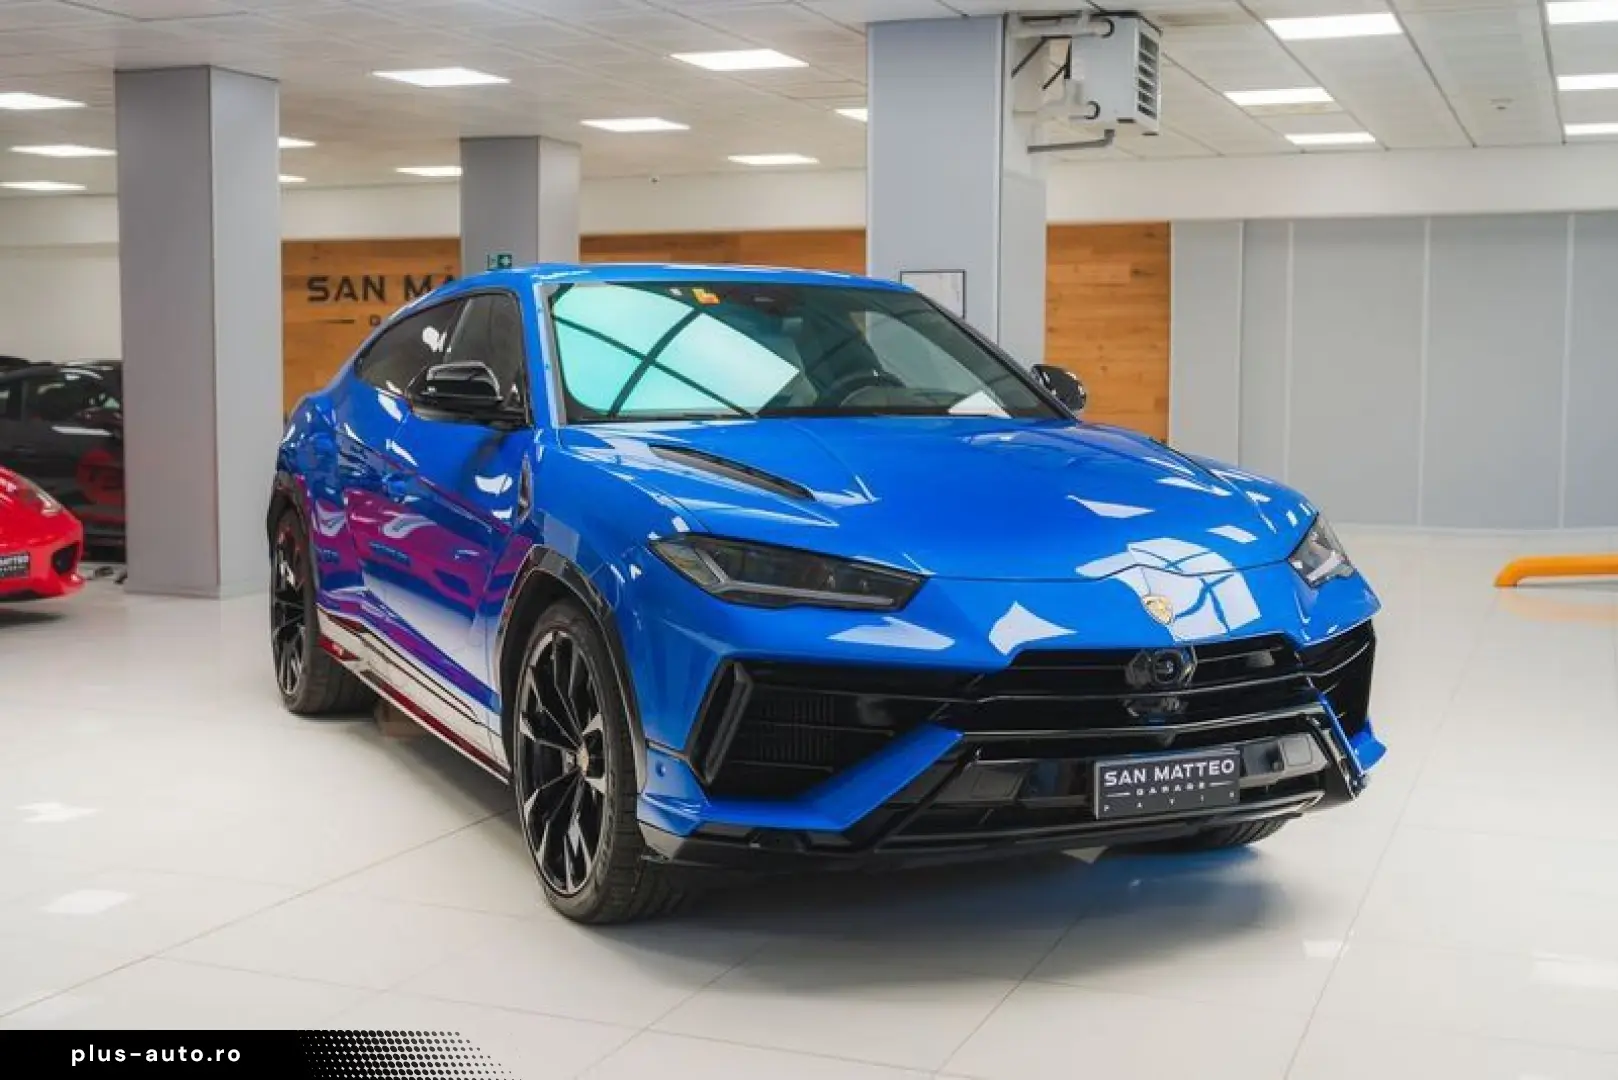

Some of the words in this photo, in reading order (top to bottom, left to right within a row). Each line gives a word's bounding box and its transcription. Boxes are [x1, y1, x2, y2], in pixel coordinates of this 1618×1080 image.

[307, 275, 385, 302] SAN
[404, 275, 455, 302] M
[1104, 768, 1146, 786] SAN
[1154, 758, 1235, 782] MATTEO
